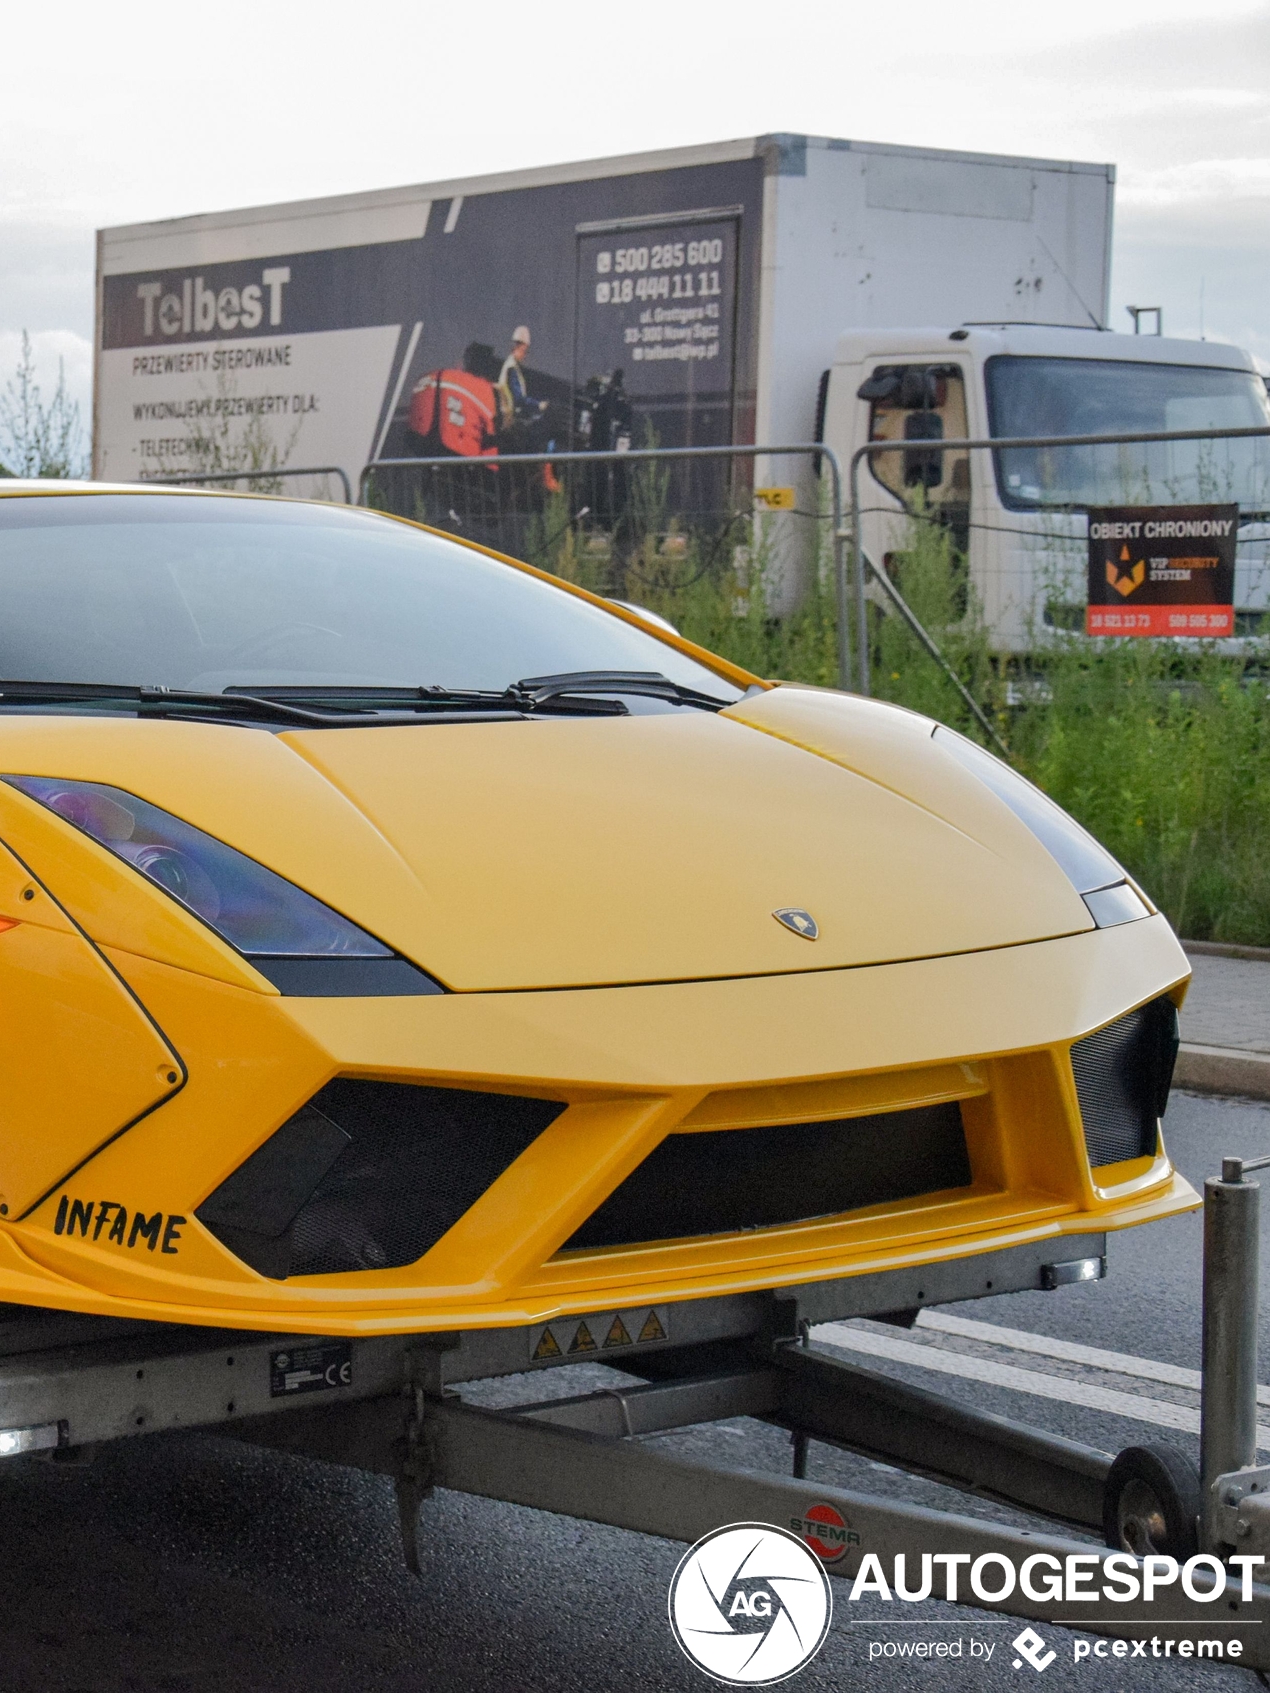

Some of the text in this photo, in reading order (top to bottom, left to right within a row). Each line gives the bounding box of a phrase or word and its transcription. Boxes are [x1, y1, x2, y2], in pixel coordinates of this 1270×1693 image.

[615, 239, 723, 273] 500 285 600
[611, 270, 721, 304] 18 444 11 11
[133, 345, 292, 376] PRZEWIERTY STEROWANE
[1090, 519, 1233, 540] OBIEKT CHRONIONY
[1149, 556, 1219, 569] VIP SECURITY
[1149, 569, 1192, 581] SYSTEM
[54, 1194, 187, 1254] INFAME
[790, 1518, 860, 1546] STEMA
